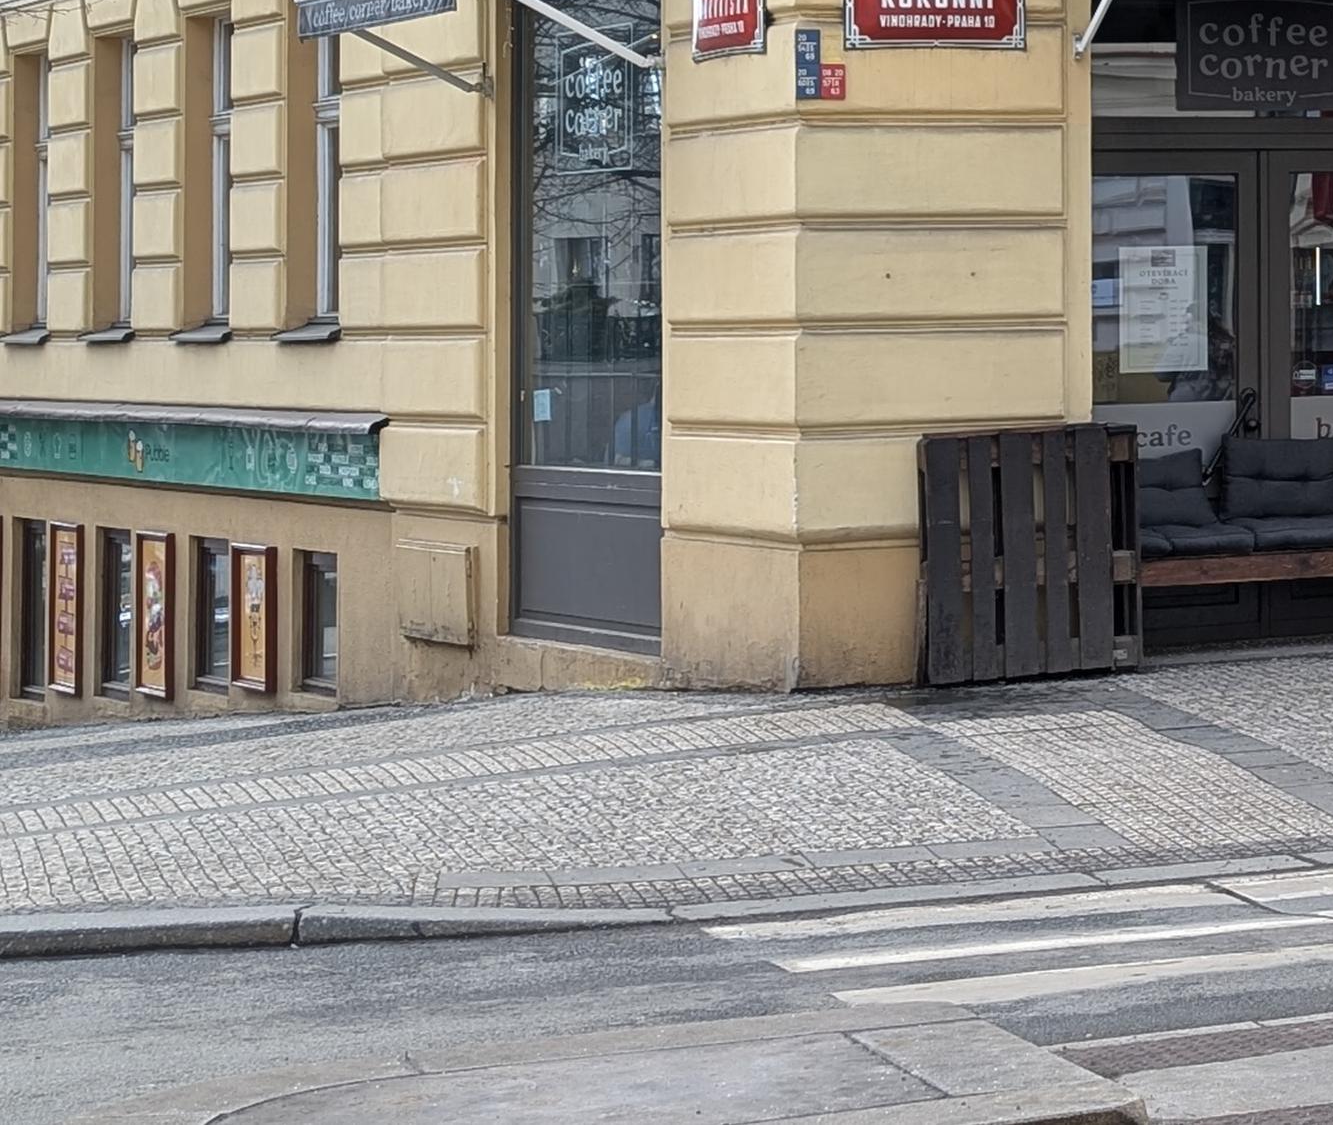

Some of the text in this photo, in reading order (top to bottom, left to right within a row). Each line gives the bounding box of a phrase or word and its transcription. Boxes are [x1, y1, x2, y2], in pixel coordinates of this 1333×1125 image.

[313, 2, 346, 26] coffee
[984, 15, 996, 28] 10
[1200, 13, 1329, 48] coffee
[1200, 50, 1329, 80] corner
[1232, 86, 1297, 105] bakery
[1136, 424, 1192, 448] cafe
